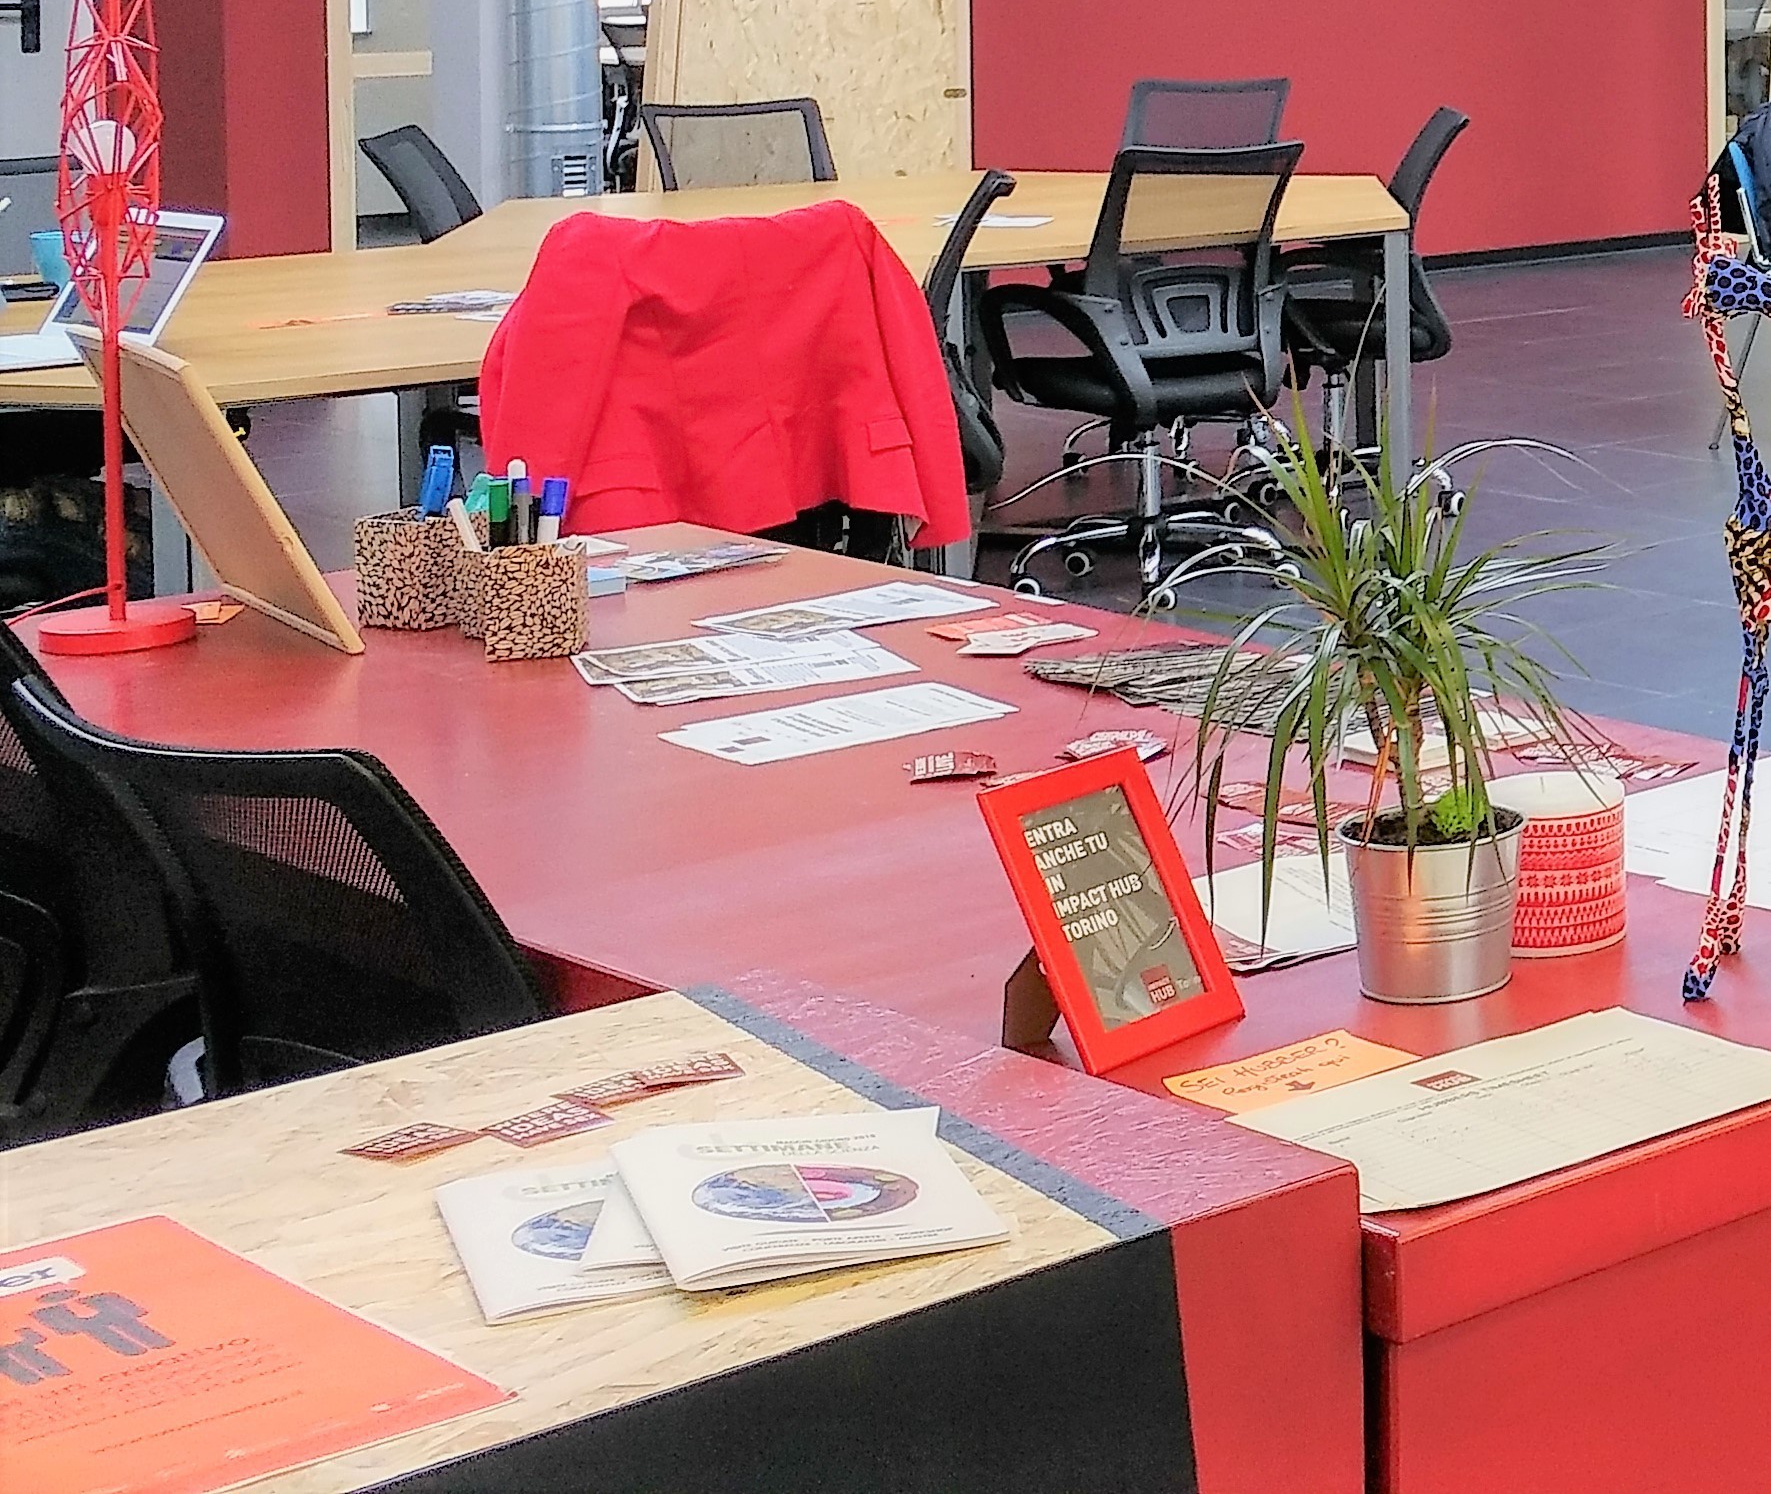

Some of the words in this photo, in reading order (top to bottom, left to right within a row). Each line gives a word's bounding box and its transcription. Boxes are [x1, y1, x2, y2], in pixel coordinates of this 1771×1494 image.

[1023, 817, 1079, 849] ENTRA
[1035, 840, 1088, 872] ANCHE
[1085, 831, 1110, 855] TU
[1044, 873, 1067, 895] IN
[1052, 886, 1109, 920] IMPACT
[1108, 873, 1144, 900] HUB
[1061, 909, 1120, 943] TORINO
[1150, 983, 1176, 1004] HUB
[1180, 1076, 1226, 1094] SEI
[1232, 1045, 1327, 1080] HUBBER
[500, 1106, 590, 1135] IDEAS
